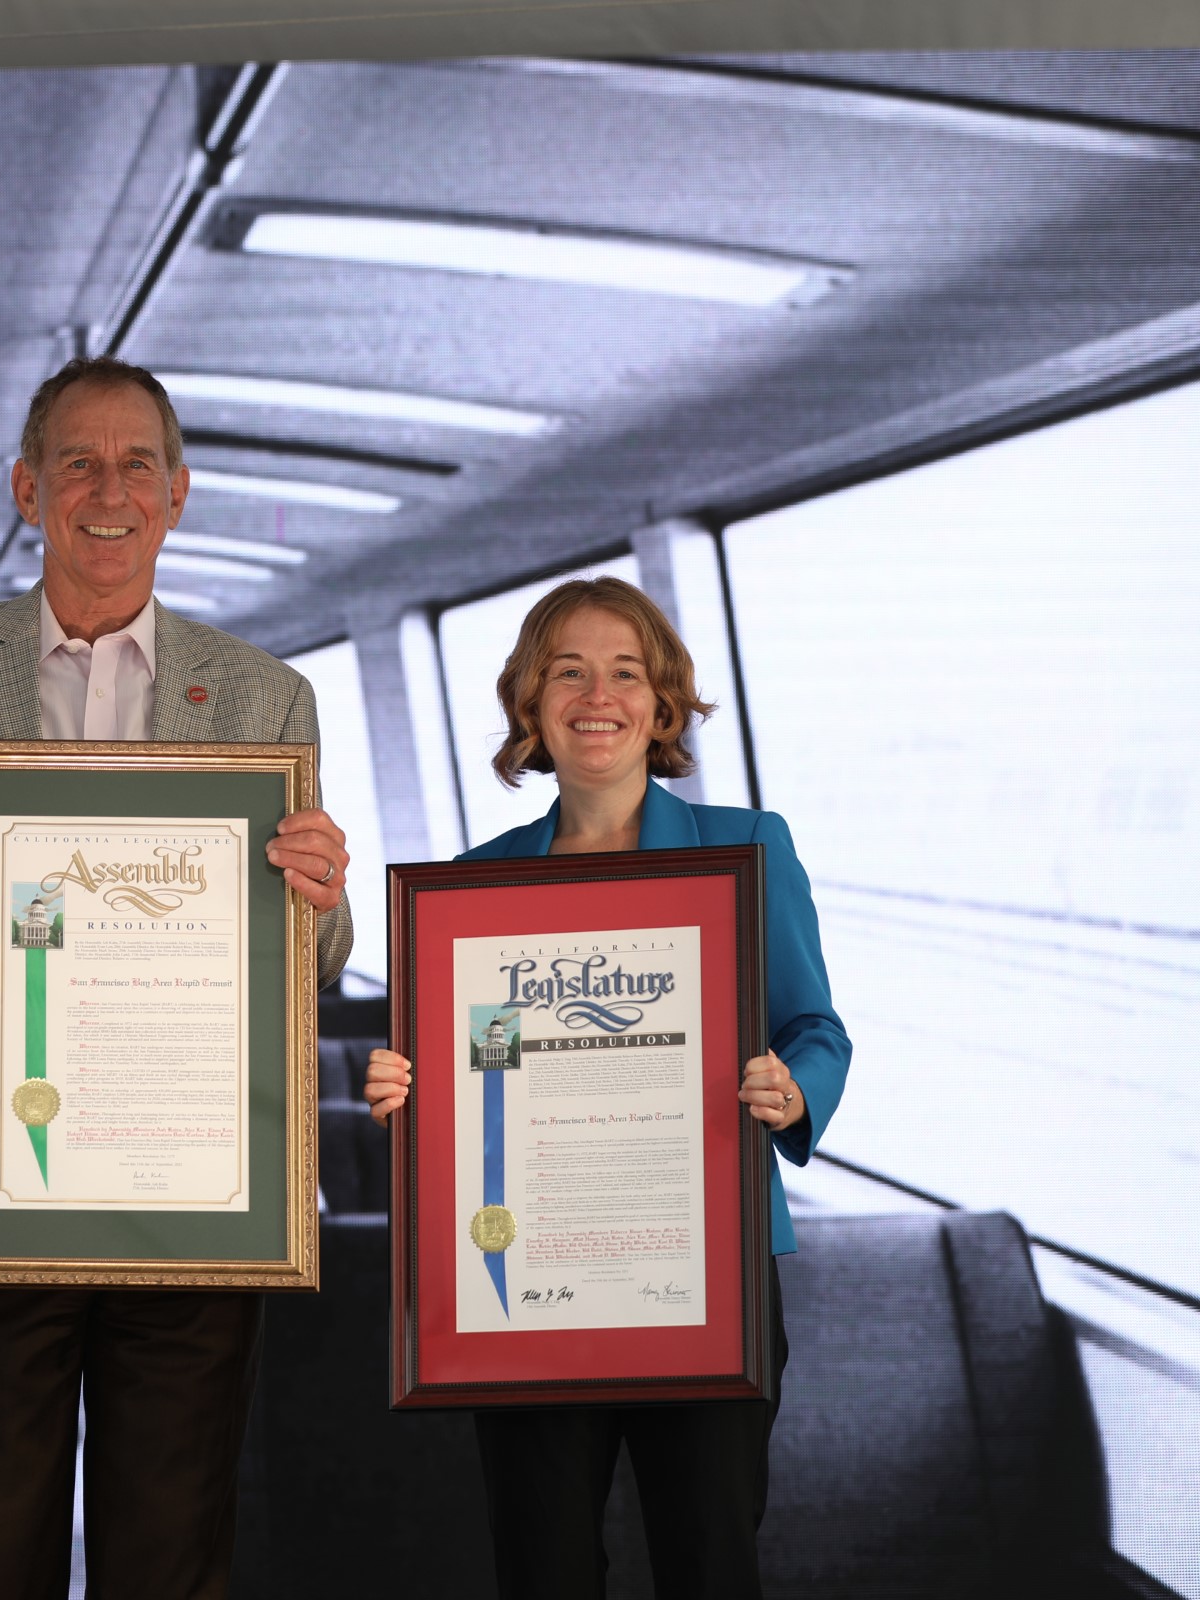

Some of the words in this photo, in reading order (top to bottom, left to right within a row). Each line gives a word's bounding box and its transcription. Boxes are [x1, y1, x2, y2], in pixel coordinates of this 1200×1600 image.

[13, 836, 109, 844] CALIFORNIA
[123, 837, 232, 845] LEGISLATURE
[40, 845, 207, 898] Assembly
[87, 921, 208, 931] RESOLUTION
[500, 942, 675, 957] CALIFORNIA
[68, 977, 88, 988] San
[89, 977, 130, 988] Francisco
[131, 977, 151, 989] Bay
[151, 977, 173, 988] Area
[174, 977, 200, 989] Rapid
[201, 977, 233, 988] Transit
[499, 954, 676, 1012] Legislature
[540, 1034, 672, 1050] RESOLUTION
[528, 1116, 547, 1127] San
[548, 1115, 587, 1128] Francisco
[588, 1114, 607, 1126] Bay
[607, 1113, 628, 1125] Area
[628, 1112, 653, 1125] Rapid
[654, 1111, 684, 1121] Transit
